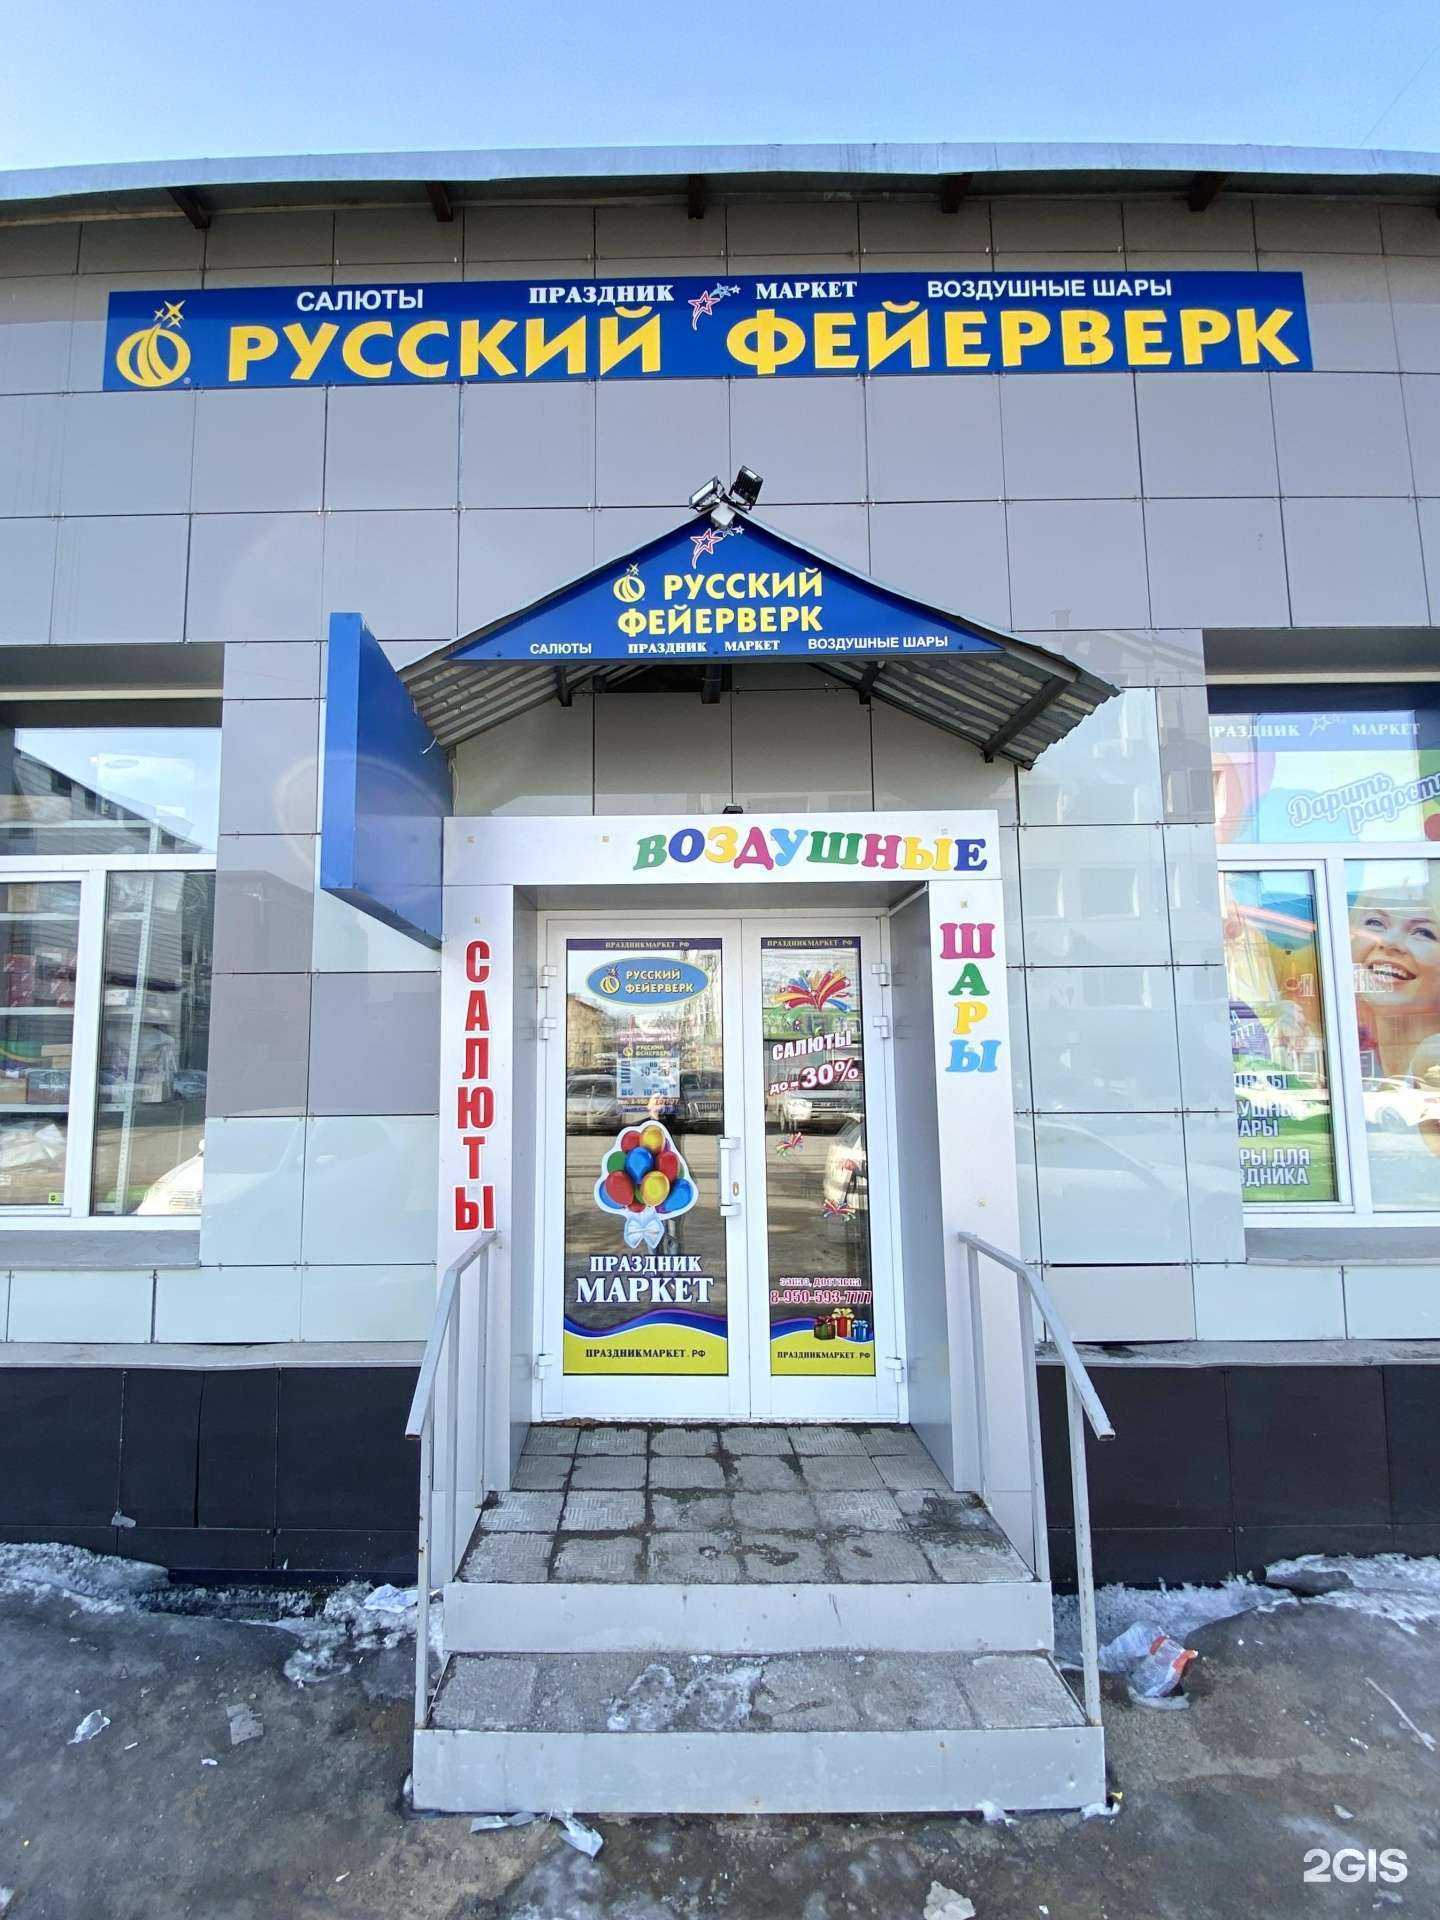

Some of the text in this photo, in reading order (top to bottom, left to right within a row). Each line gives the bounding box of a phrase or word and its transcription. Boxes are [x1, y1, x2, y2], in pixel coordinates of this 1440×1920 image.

[297, 289, 424, 312] САЛЮТЫ
[529, 280, 857, 306] ПРАЗДНИК МАРКЕТ
[927, 278, 1172, 300] ВОЗДУШНЫЕ ШАРЫ
[227, 300, 1300, 382] РУССКИЙ ФЕЙЕРВЕРК
[664, 567, 823, 600] РУССКИЙ
[617, 604, 823, 637] ФЕЙЕРВЕРК
[530, 642, 592, 655] САЛЮТЫ
[628, 639, 782, 655] ПРАЗДНИК МАРКЕТ
[808, 635, 948, 651] ВОЗДУШНЫЕ ШАРЫ
[1353, 723, 1420, 736] МАРКЕТ
[1289, 773, 1392, 827] Дарить
[1346, 773, 1440, 833] радост
[632, 826, 988, 872] ВОЗДУШНЫЕ
[625, 968, 680, 981] РУССКИЙ
[624, 982, 695, 994] ФЕЙЕРВЕРК
[939, 922, 1001, 1073] ШАРЫ
[772, 1031, 851, 1060] САЛЮТЫ
[453, 939, 496, 1232] САЛЮТЫ
[1272, 1148, 1311, 1168] ДЛЯ
[590, 1255, 702, 1274] ПРАЗДНИК
[576, 1276, 713, 1304] МАРКЕТ
